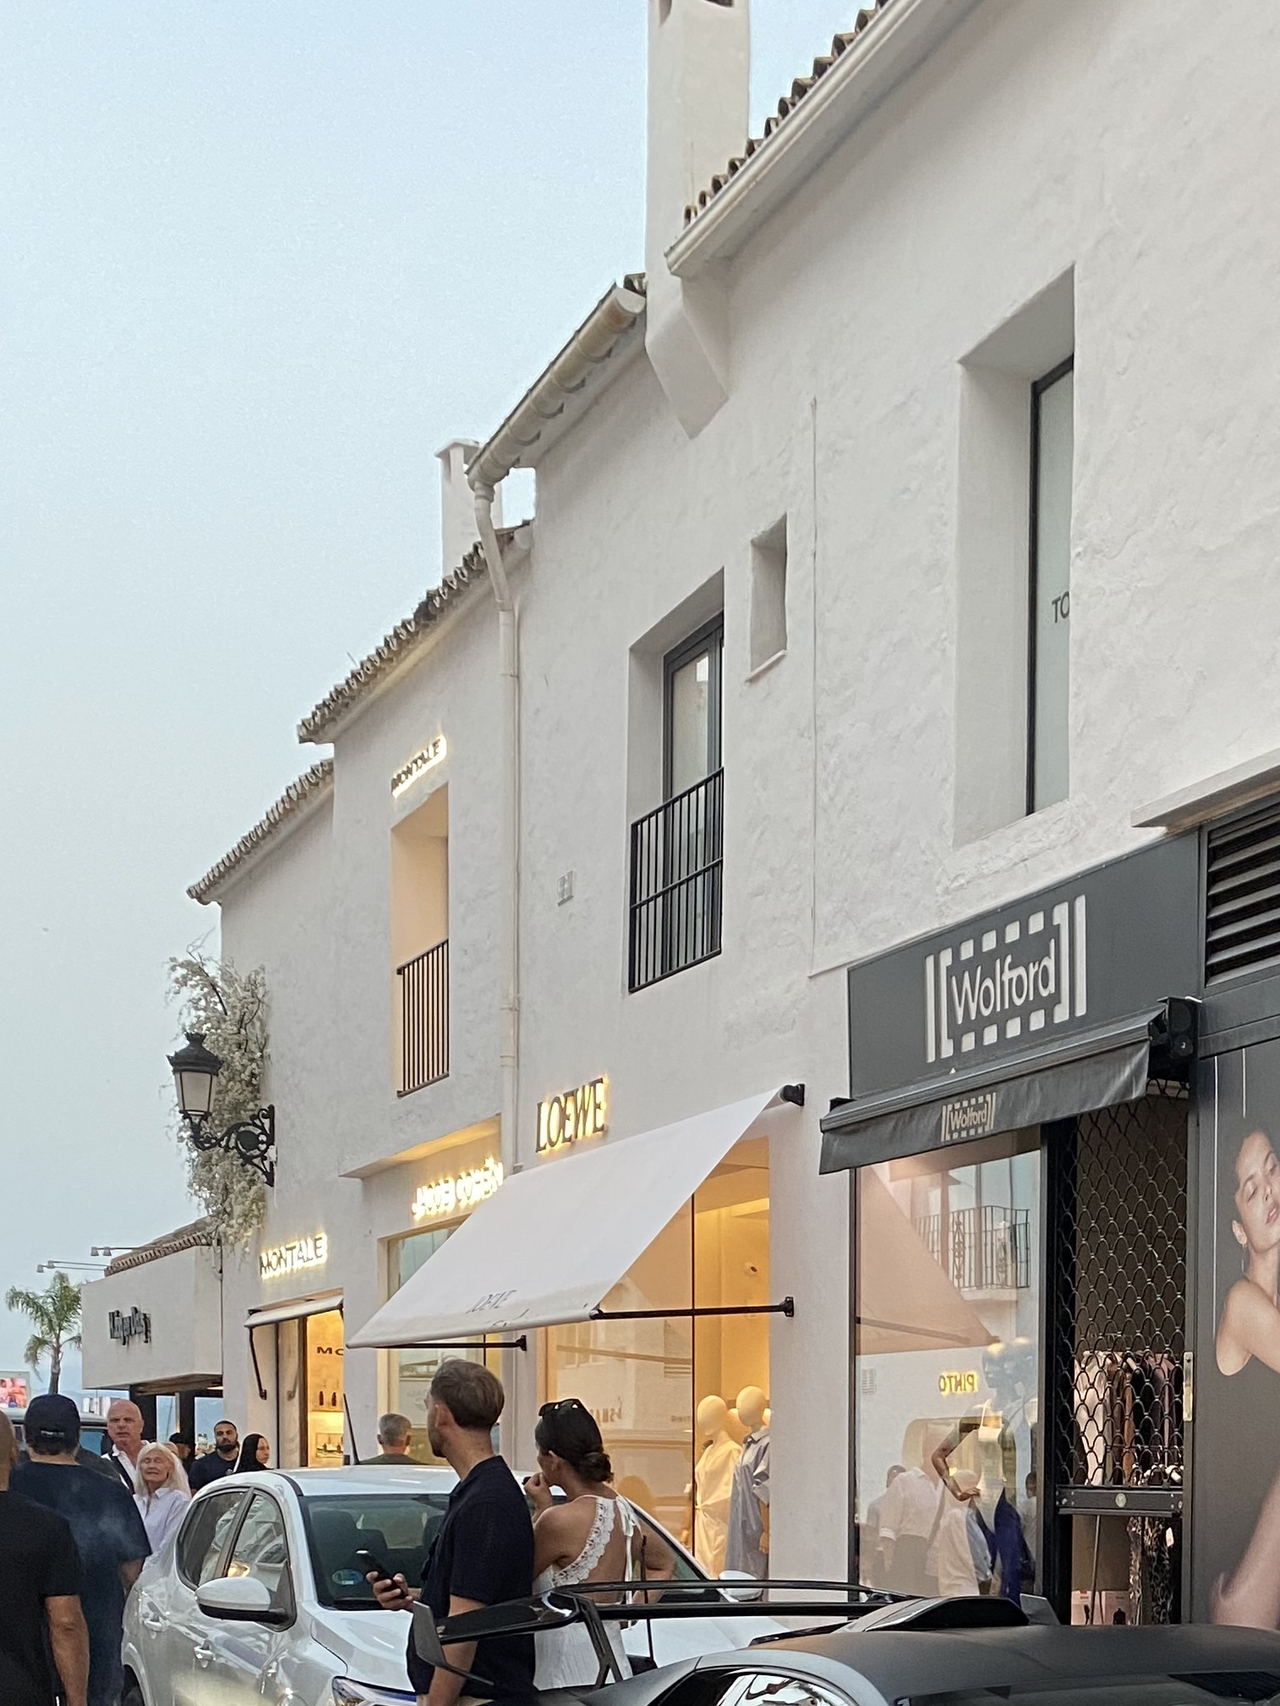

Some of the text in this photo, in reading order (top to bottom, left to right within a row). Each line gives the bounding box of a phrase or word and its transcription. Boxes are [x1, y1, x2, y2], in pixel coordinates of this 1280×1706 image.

[951, 938, 1056, 1025] Wolford
[535, 1077, 605, 1153] LOEWE
[950, 1103, 988, 1131] Wolford
[259, 1236, 325, 1278] MONTALE
